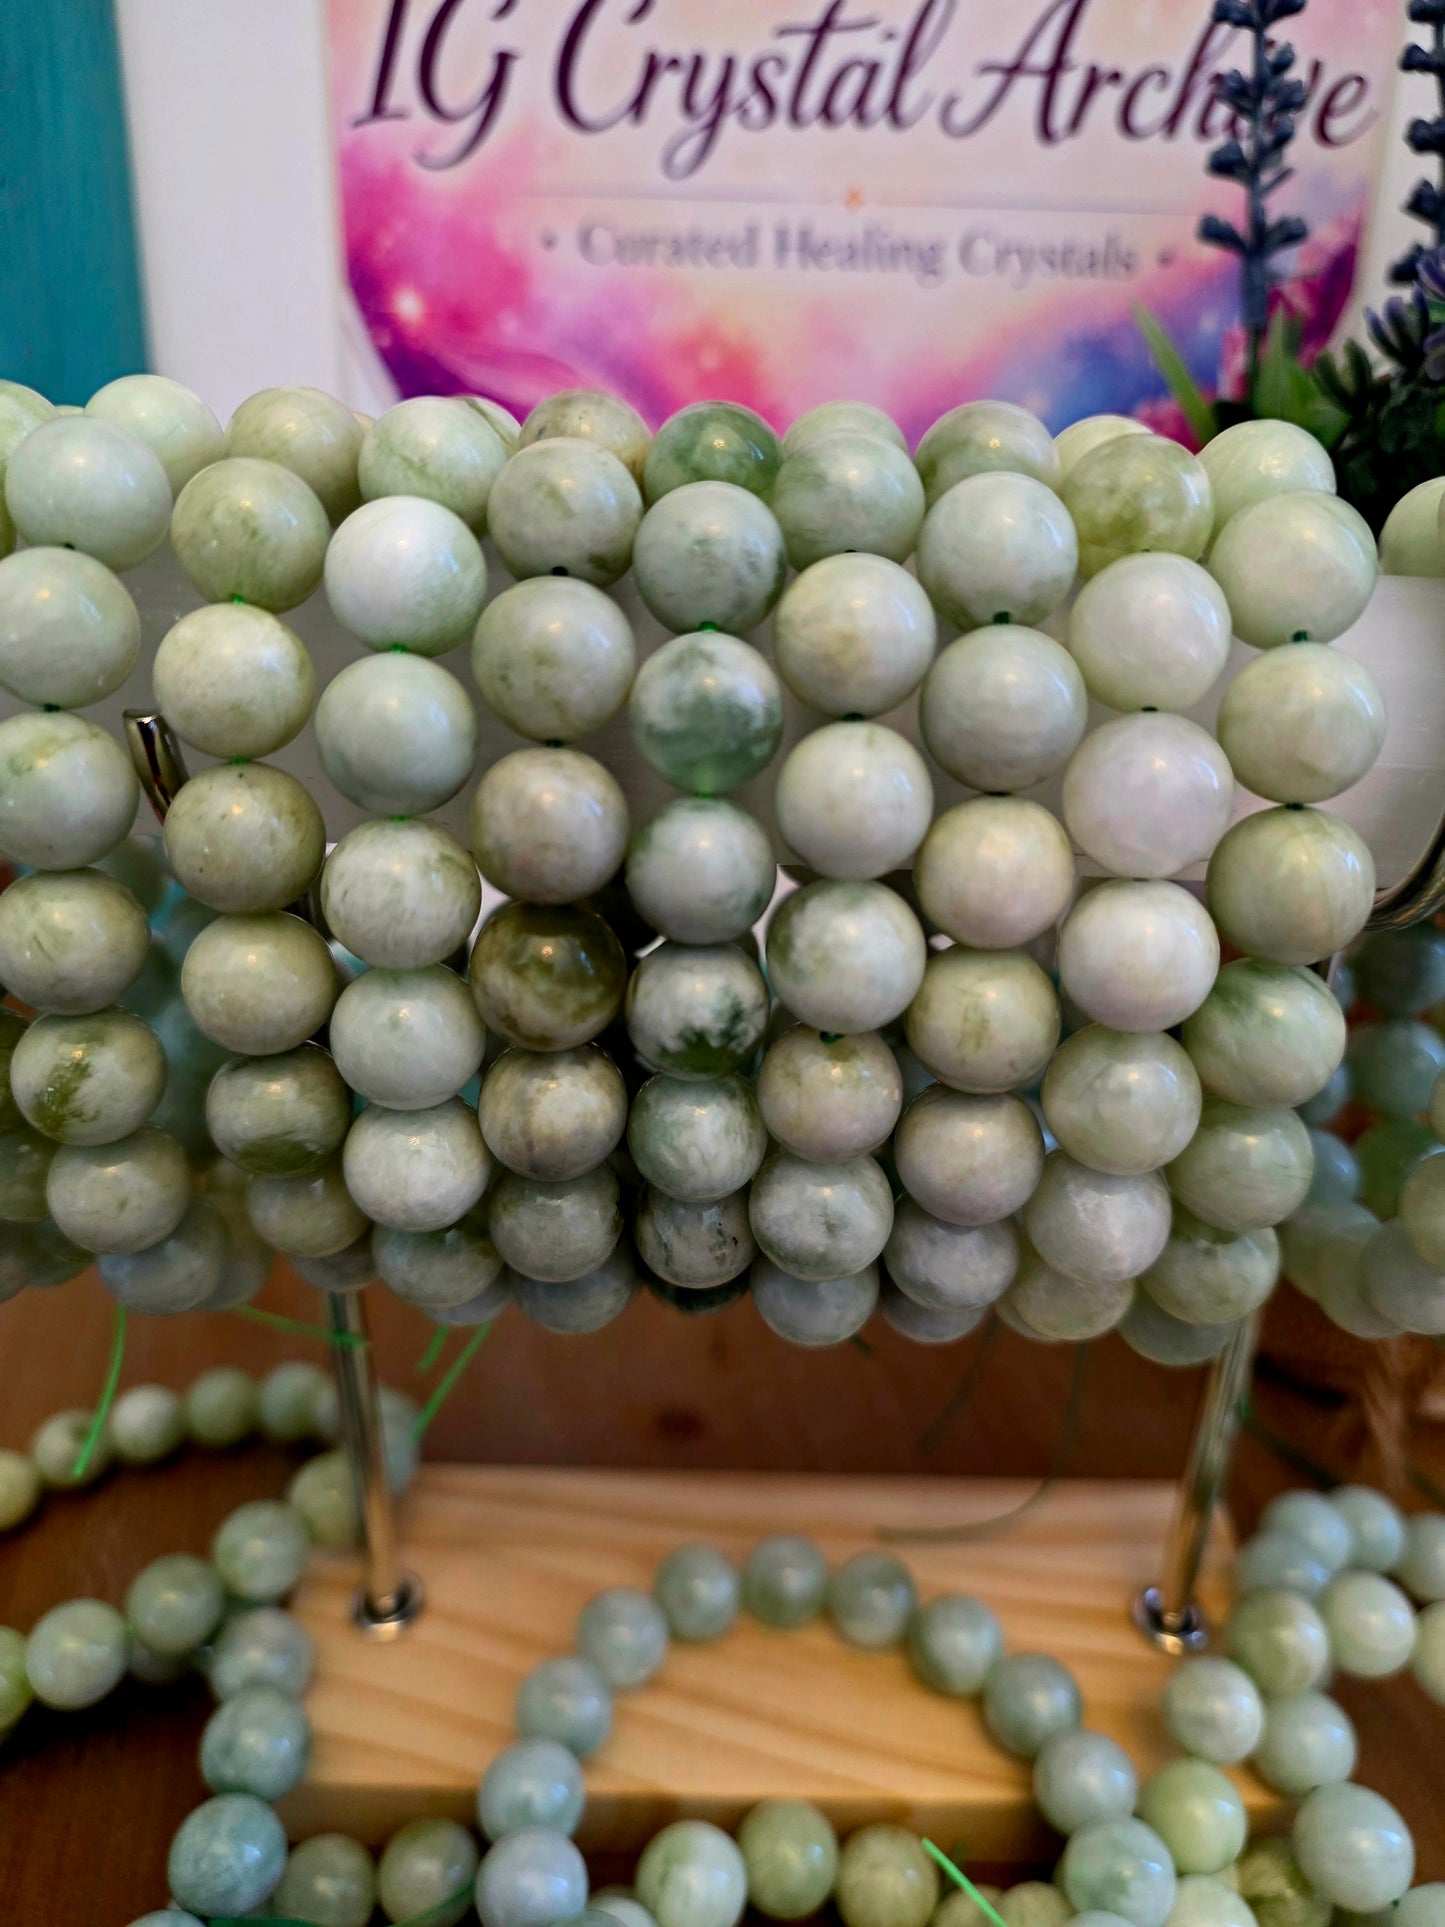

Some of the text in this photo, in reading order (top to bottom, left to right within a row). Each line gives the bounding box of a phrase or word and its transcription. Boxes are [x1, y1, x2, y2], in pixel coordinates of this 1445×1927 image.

[350, 0, 520, 172] IG
[552, 0, 958, 181] Crystal
[577, 219, 1141, 291] Curated Healing Crystals
